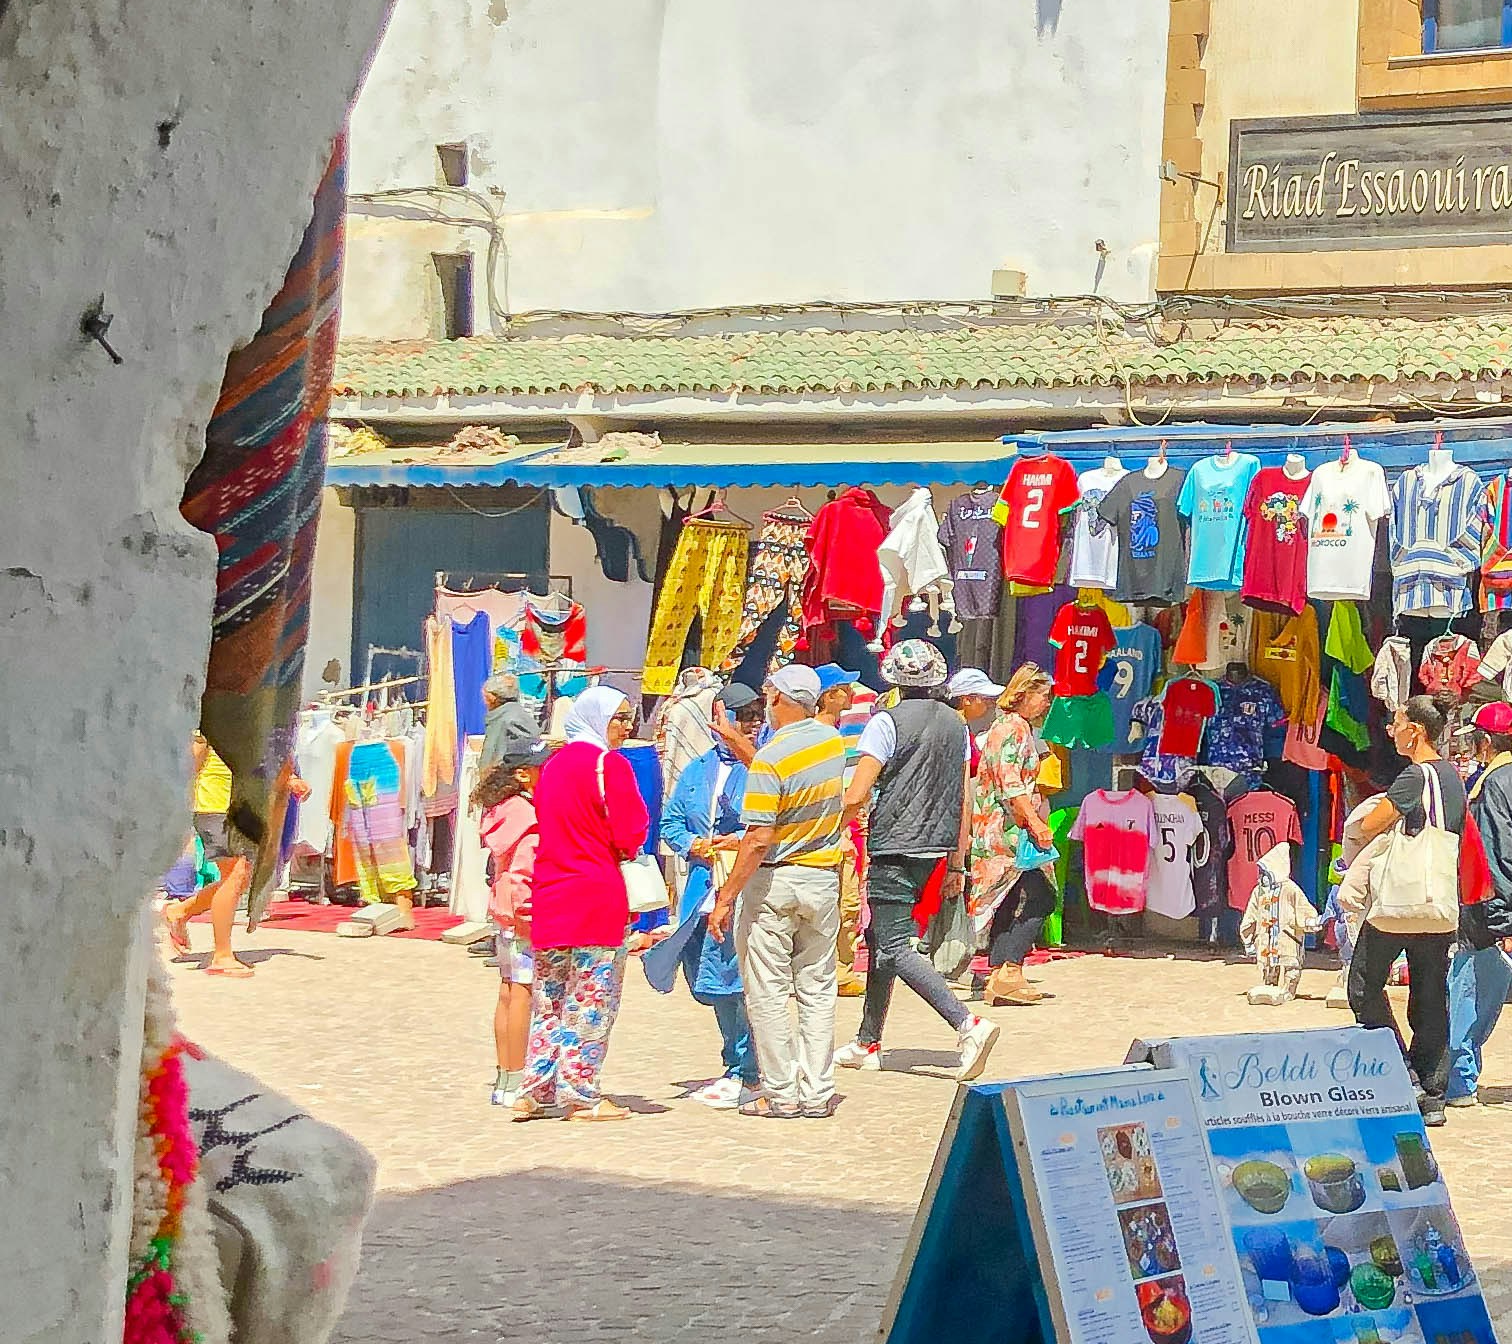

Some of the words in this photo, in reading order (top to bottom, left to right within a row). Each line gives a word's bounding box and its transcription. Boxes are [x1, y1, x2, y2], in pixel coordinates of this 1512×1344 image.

[1242, 150, 1337, 219] Riad
[1021, 488, 1044, 529] 2
[1067, 625, 1099, 638] HAKIMI
[1074, 640, 1088, 673] 2
[1106, 647, 1143, 661] AALAND
[1113, 661, 1134, 699] 9
[1243, 812, 1275, 822] MESSI
[1161, 827, 1176, 863] 5
[1242, 825, 1277, 863] 10
[1224, 1052, 1318, 1090] Beldi
[1323, 1048, 1393, 1084] Chic
[1260, 1089, 1323, 1107] Blown
[1327, 1085, 1376, 1103] Glass
[1281, 1109, 1311, 1121] bouche
[1312, 1109, 1333, 1119] verre
